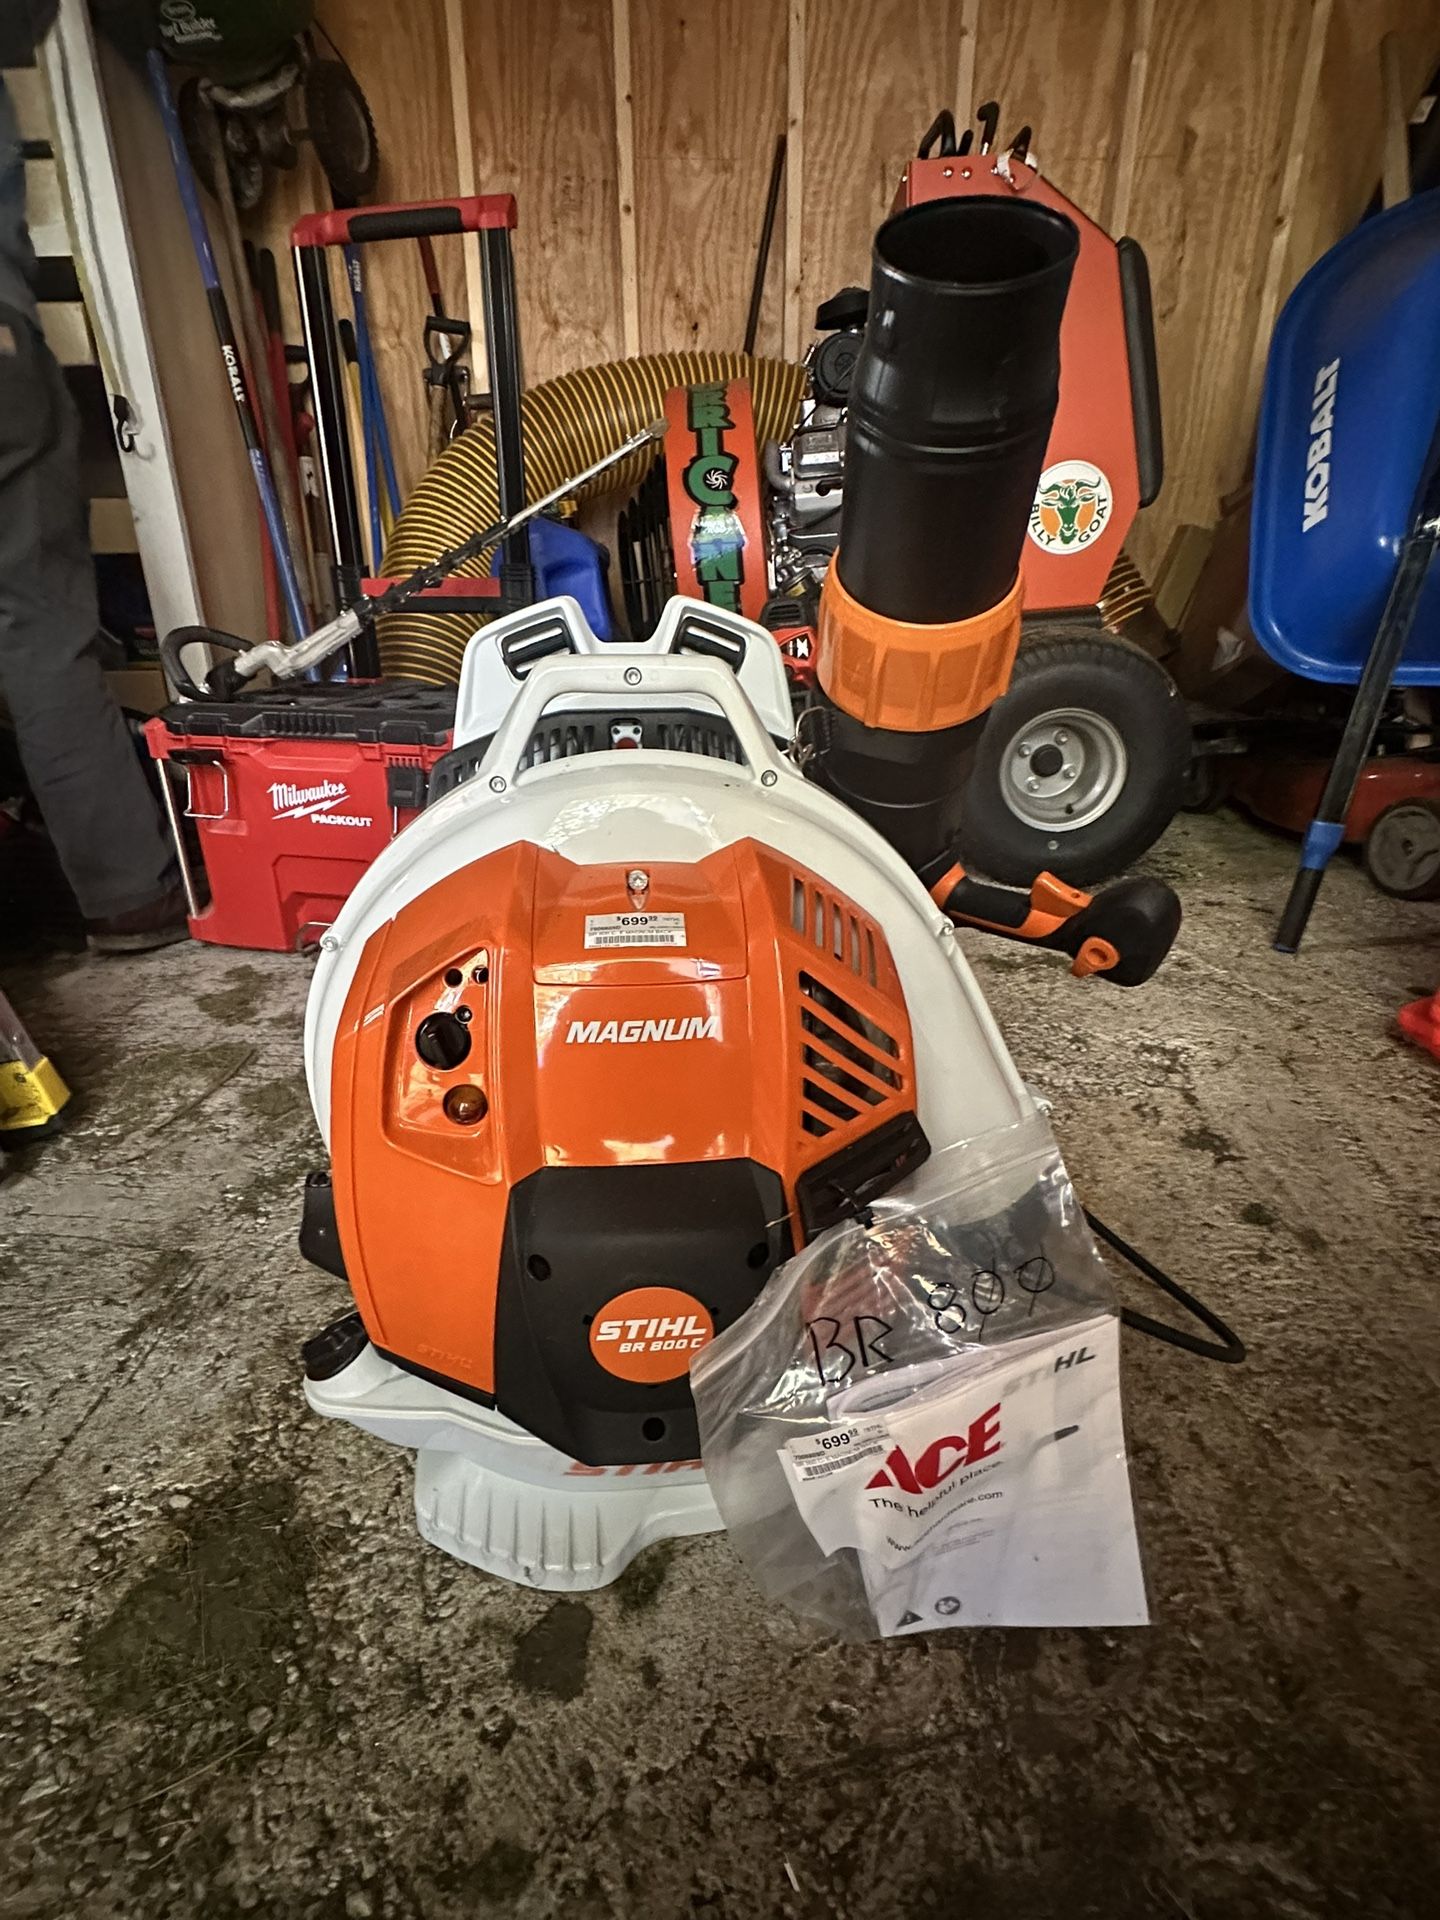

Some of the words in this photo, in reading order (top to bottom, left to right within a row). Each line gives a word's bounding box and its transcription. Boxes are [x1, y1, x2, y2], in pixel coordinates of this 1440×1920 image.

[222, 344, 246, 402] KOBALT
[1302, 357, 1341, 533] KOBALT
[1030, 503, 1056, 546] BILLY
[1078, 495, 1107, 543] GOAT
[266, 779, 347, 811] Milwaukee
[311, 813, 373, 827] PACKOUT
[565, 1015, 724, 1044] MAGNUM
[596, 1315, 707, 1341] STIHL
[619, 1342, 646, 1353] BR
[649, 1339, 689, 1352] 800
[690, 1337, 704, 1349] C
[806, 1316, 895, 1386] BR
[864, 1402, 1002, 1495] ACE
[868, 1498, 904, 1512] The
